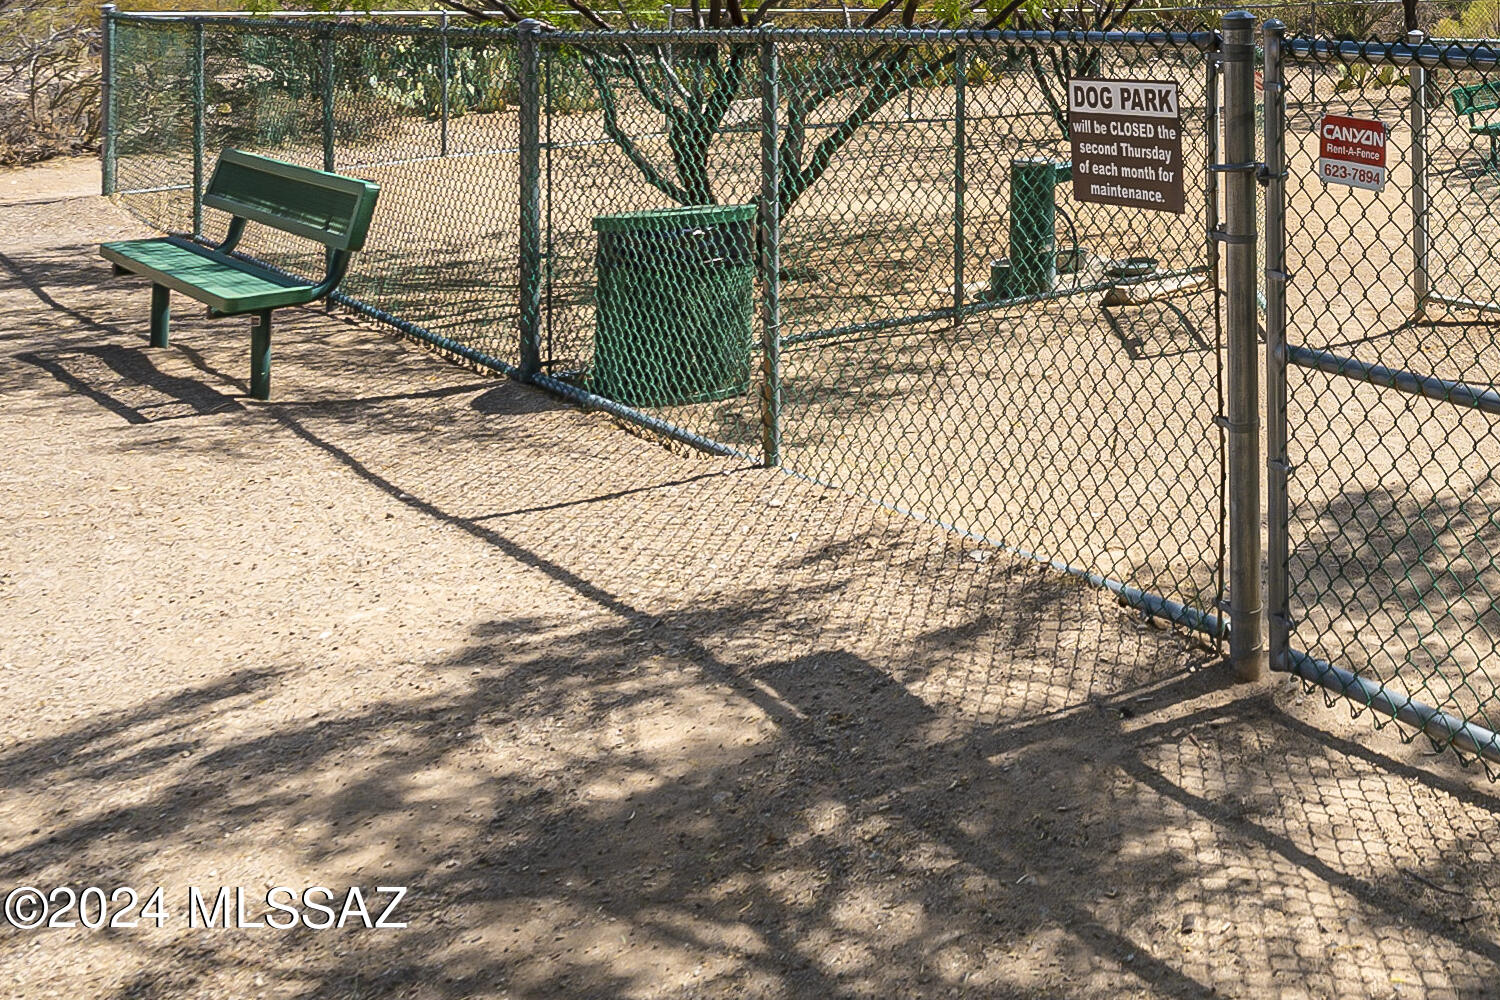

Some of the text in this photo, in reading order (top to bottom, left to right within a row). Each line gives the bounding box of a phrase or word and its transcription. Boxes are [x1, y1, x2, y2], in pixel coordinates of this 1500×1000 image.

[1074, 86, 1174, 113] DOG PARK
[1072, 120, 1177, 140] will be CLOSED the
[1323, 124, 1384, 148] CANYON
[1079, 142, 1172, 165] second Thursday
[1326, 143, 1380, 160] Rent-A-Fence
[1079, 160, 1174, 183] of each month for
[1324, 163, 1380, 185] 623-7894
[1090, 182, 1165, 203] maintenance.
